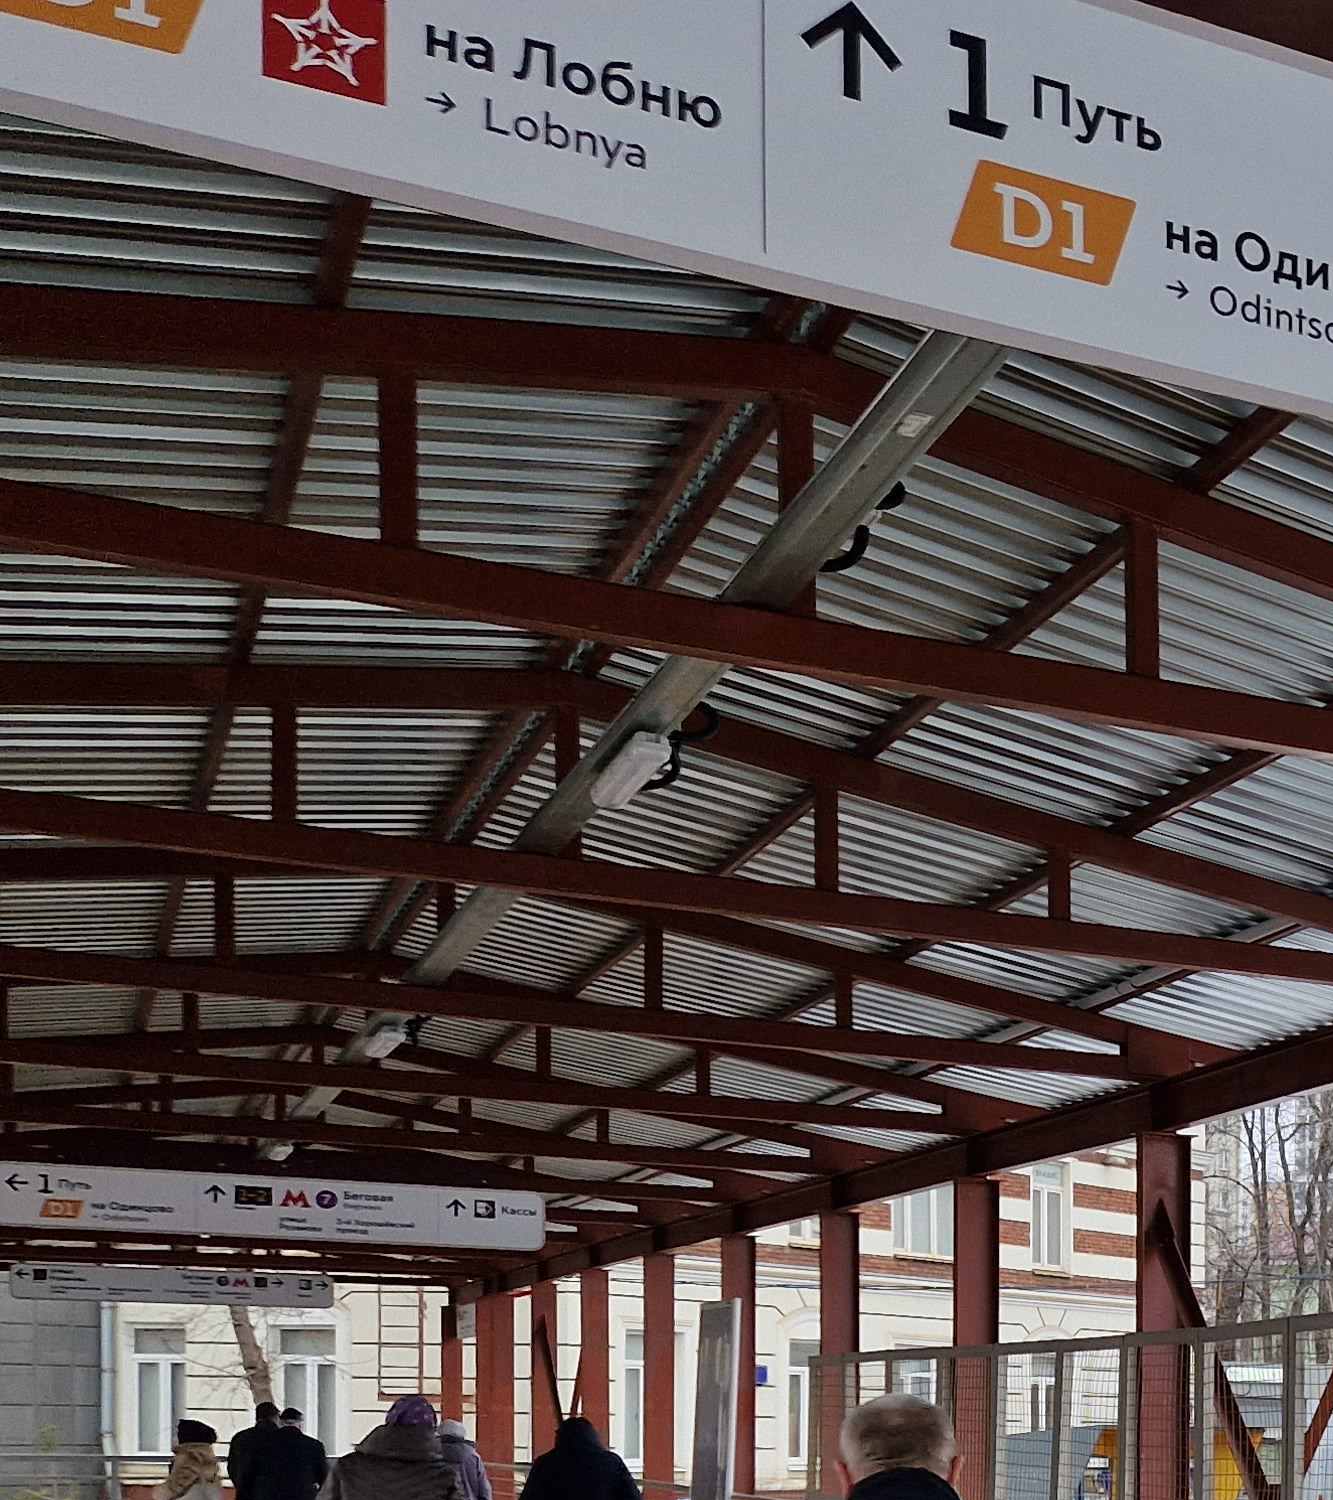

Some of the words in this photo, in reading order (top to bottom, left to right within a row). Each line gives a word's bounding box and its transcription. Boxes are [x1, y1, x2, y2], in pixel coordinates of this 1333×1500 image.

[424, 23, 495, 73] на
[512, 37, 723, 129] Лобню
[947, 28, 1009, 141] 1
[1031, 74, 1163, 152] Путь
[484, 97, 647, 170] Lobnya
[991, 181, 1097, 266] D1
[1165, 220, 1220, 263] на
